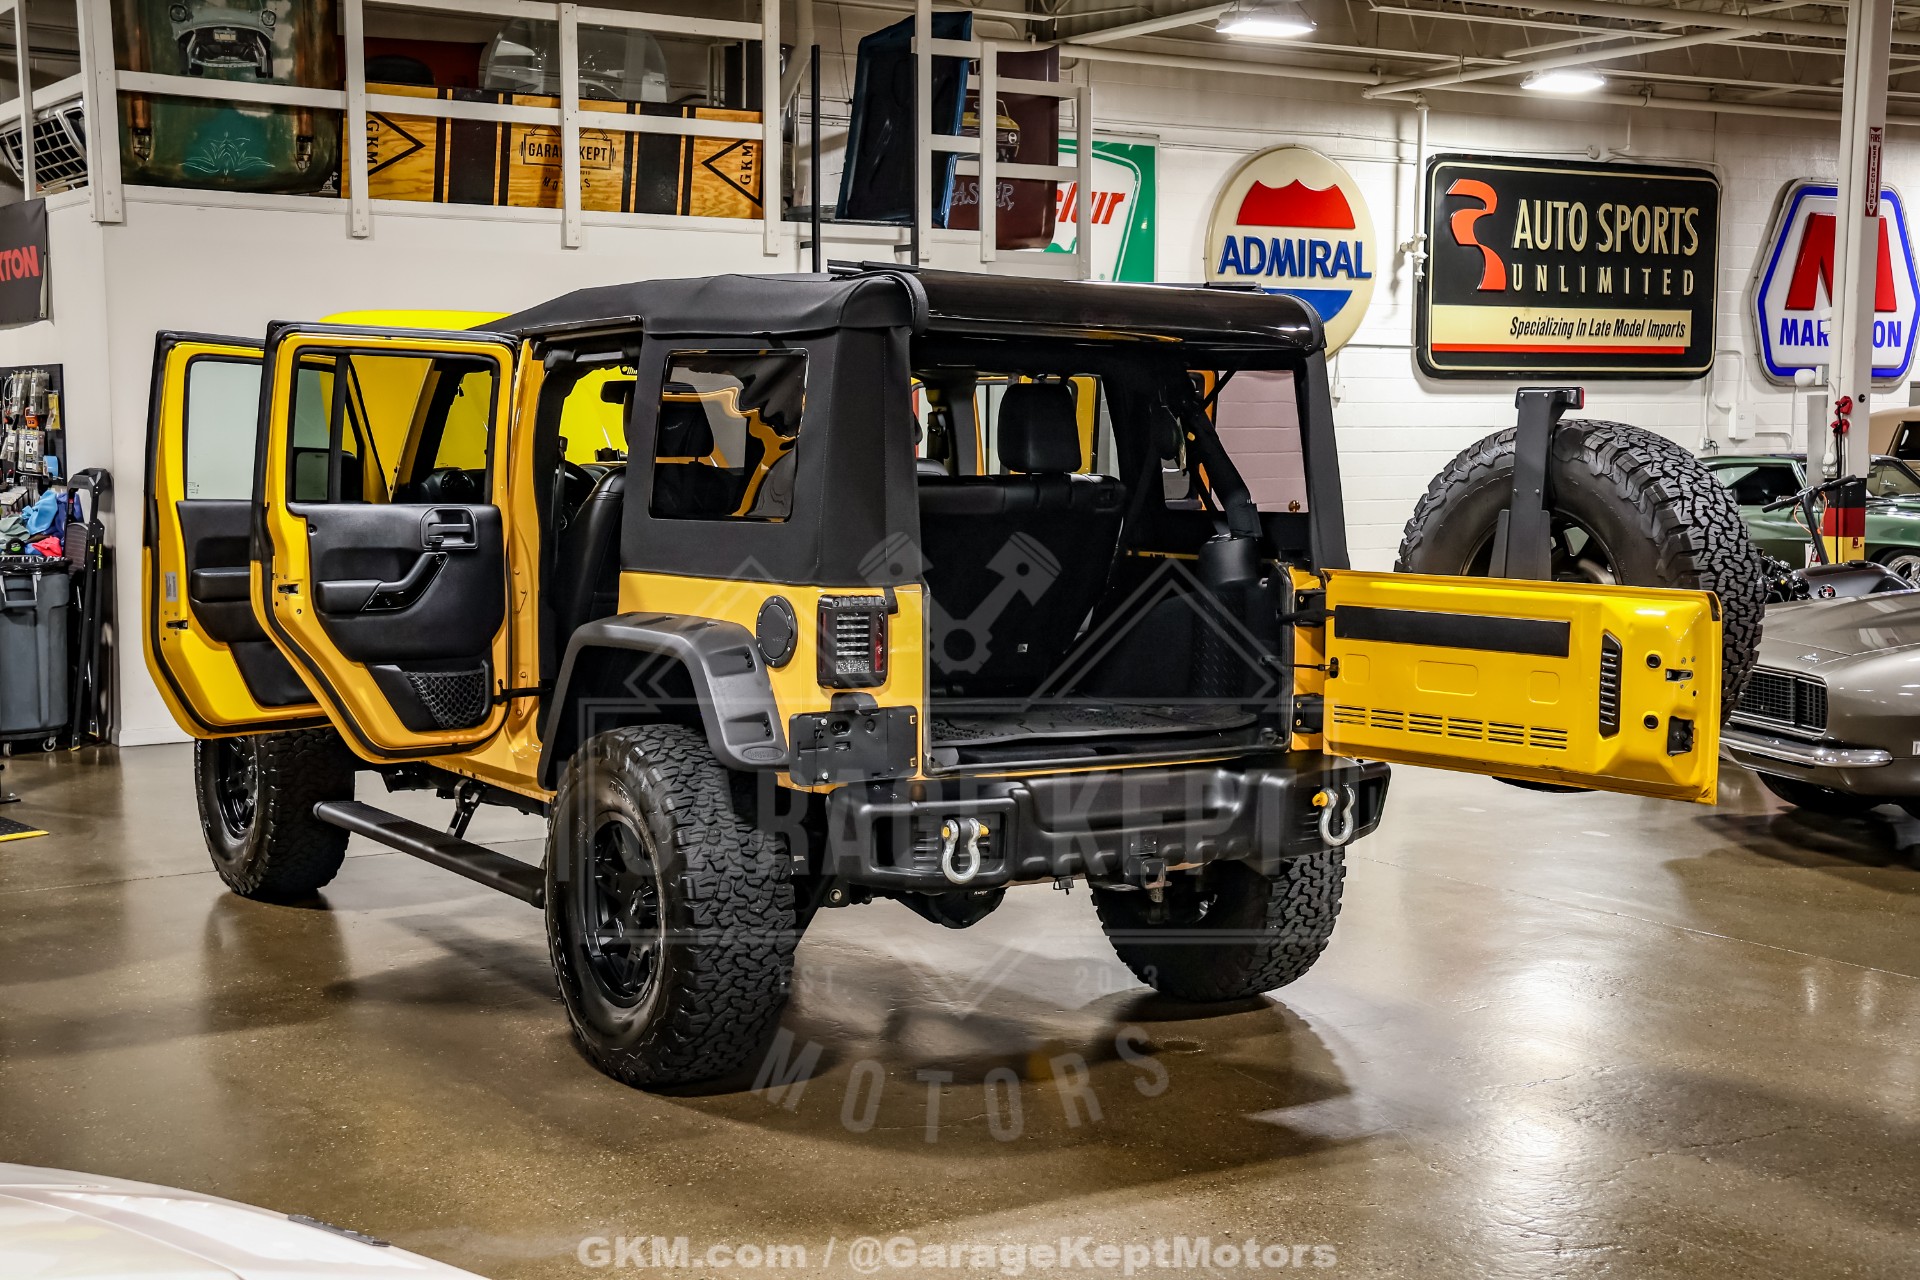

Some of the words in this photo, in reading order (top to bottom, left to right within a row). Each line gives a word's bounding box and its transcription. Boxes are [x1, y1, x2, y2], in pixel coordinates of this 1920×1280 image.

[366, 120, 380, 165] GKM
[528, 142, 563, 159] GARA
[579, 145, 608, 162] KEPT
[1871, 133, 1881, 142] FIRE
[740, 144, 754, 186] GKM
[1869, 145, 1877, 210] EXTINGUISHER
[1511, 198, 1589, 253] AUTO
[1596, 201, 1699, 257] SPORTS
[1217, 235, 1373, 279] ADMIRAL
[1511, 262, 1695, 296] UNLIMITED
[1510, 316, 1575, 340] Specializing
[1575, 317, 1587, 337] In
[1588, 317, 1611, 337] Late
[1612, 318, 1646, 338] Model
[1647, 319, 1686, 341] Imports
[1779, 317, 1902, 349] MARON
